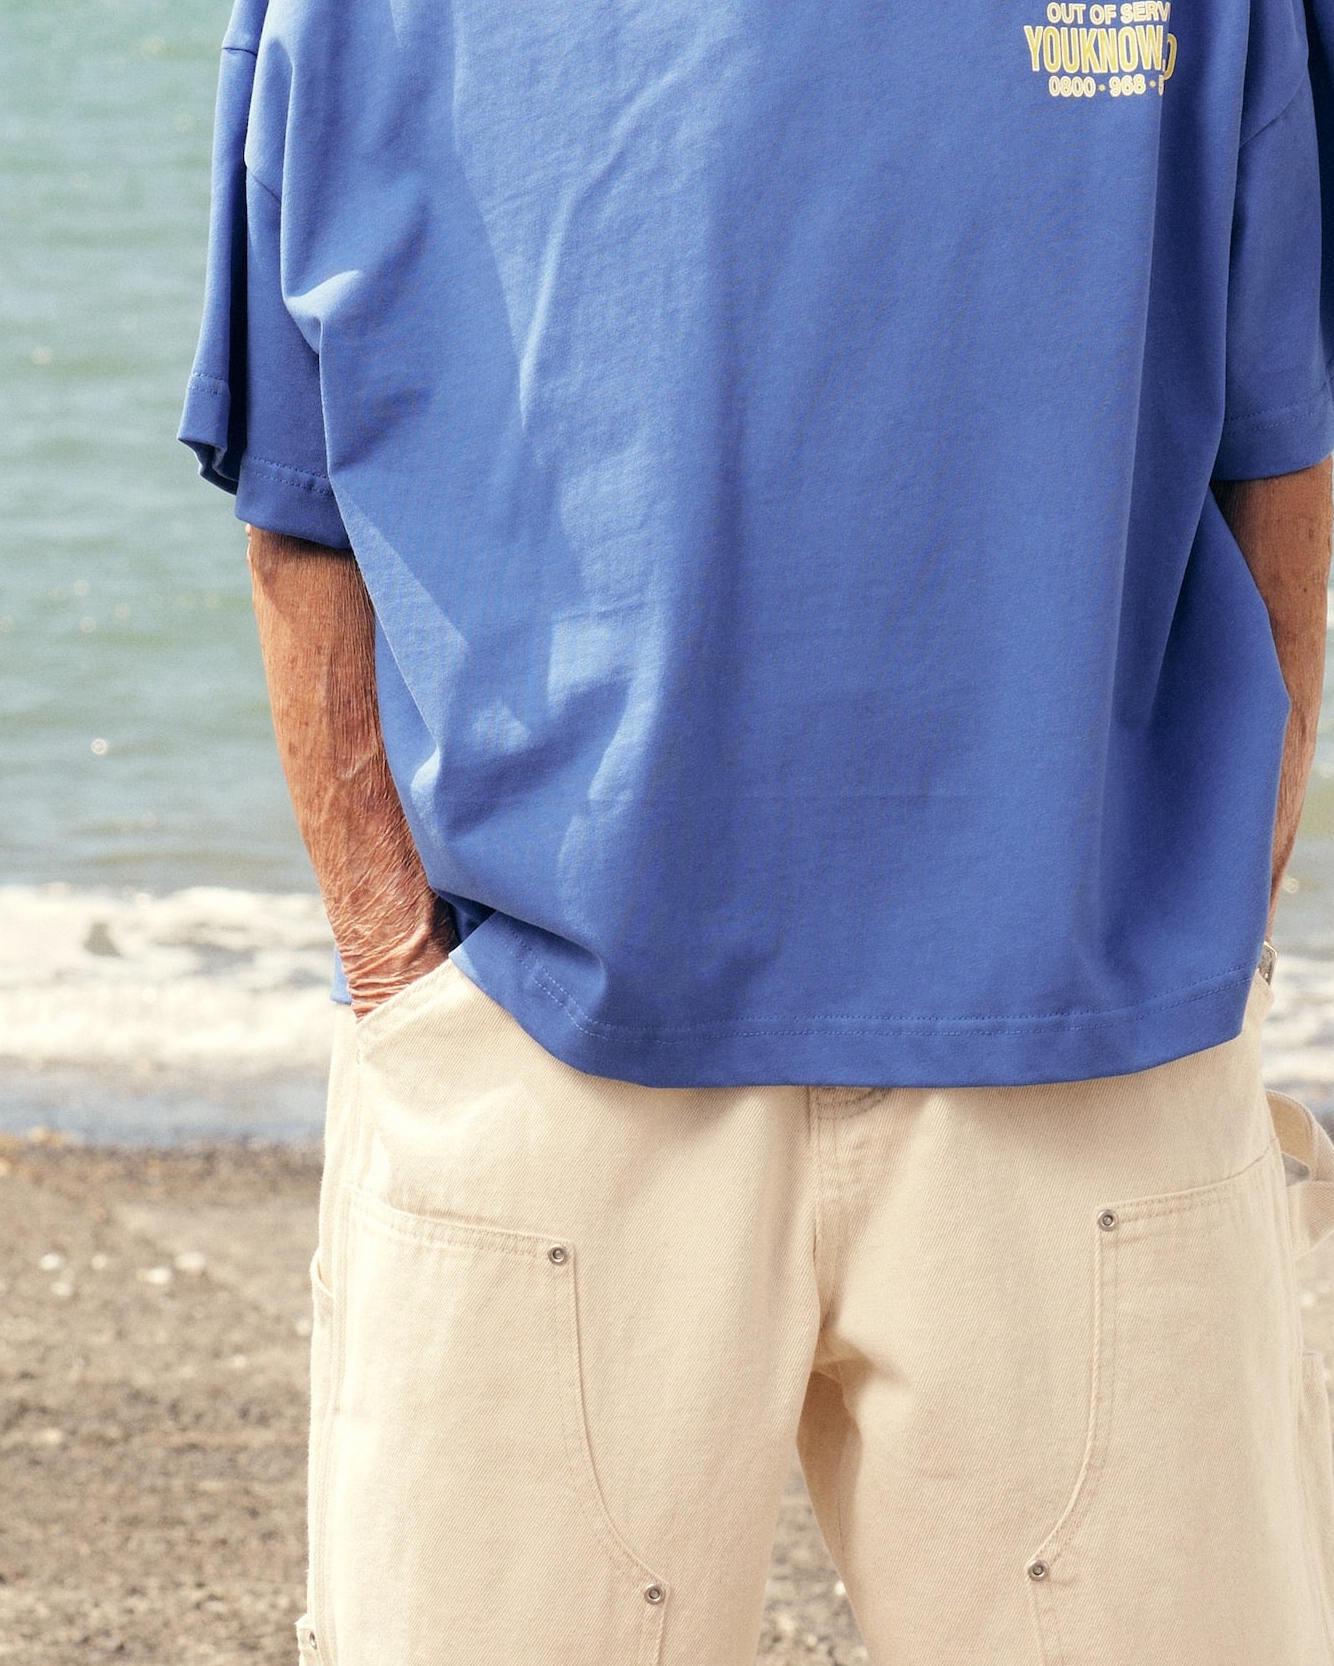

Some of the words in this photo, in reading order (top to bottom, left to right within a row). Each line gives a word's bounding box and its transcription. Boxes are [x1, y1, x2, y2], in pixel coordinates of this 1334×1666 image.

[1047, 1, 1086, 24] OUT
[1089, 4, 1117, 25] OF
[1120, 0, 1171, 24] SERV
[1048, 75, 1096, 98] 0800
[1109, 73, 1146, 97] 968
